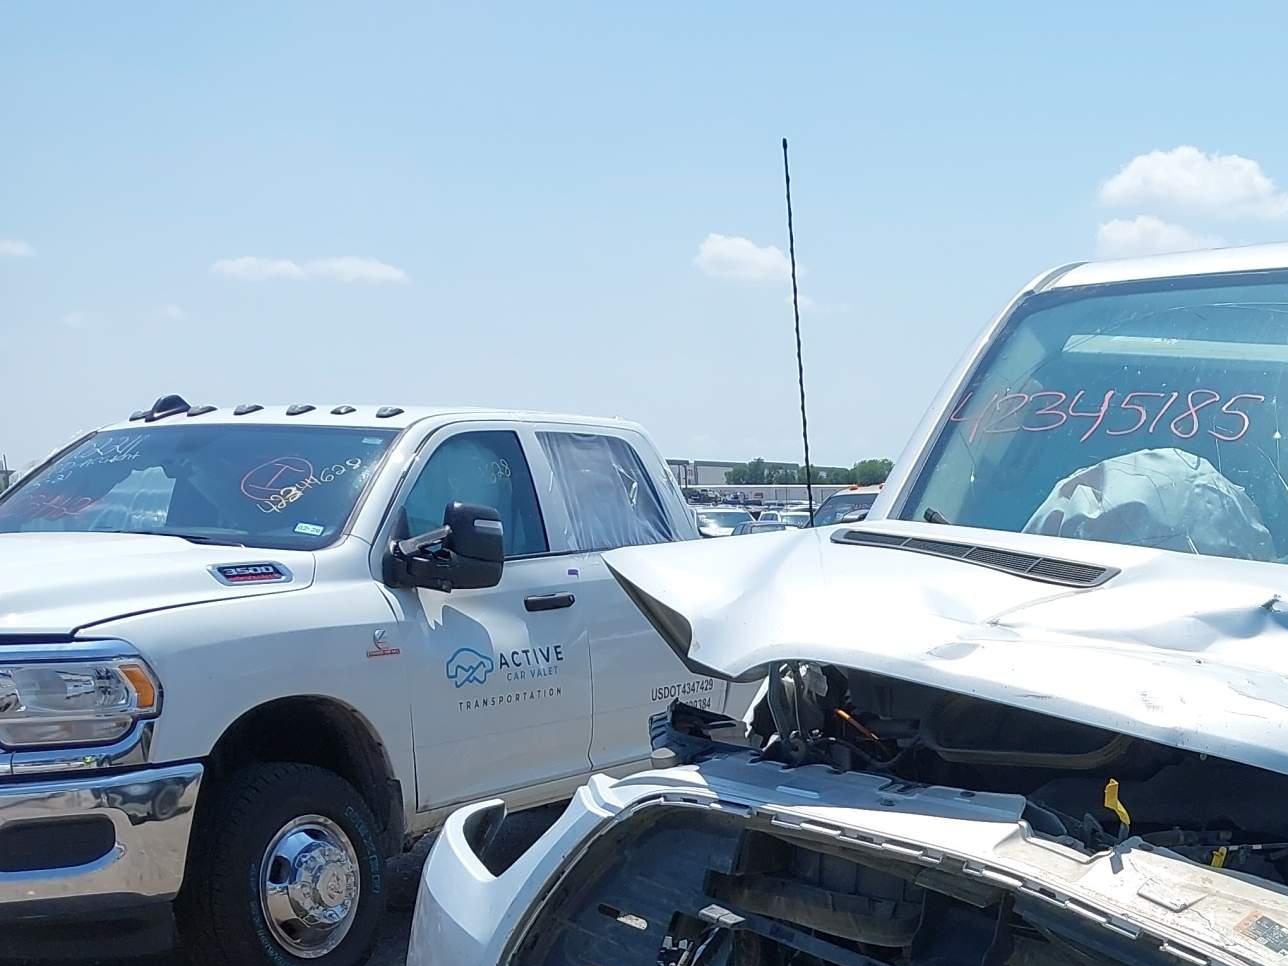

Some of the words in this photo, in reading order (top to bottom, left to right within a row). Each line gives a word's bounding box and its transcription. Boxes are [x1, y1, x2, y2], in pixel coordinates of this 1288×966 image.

[950, 390, 1265, 442] 42345185
[256, 457, 361, 513] 42344628
[223, 565, 274, 576] 3500
[499, 645, 564, 669] ACTIVE
[506, 671, 526, 681] CAR
[530, 666, 559, 678] VALET
[458, 687, 562, 712] TRANSPORTATION
[651, 678, 714, 702] USDOT4347429
